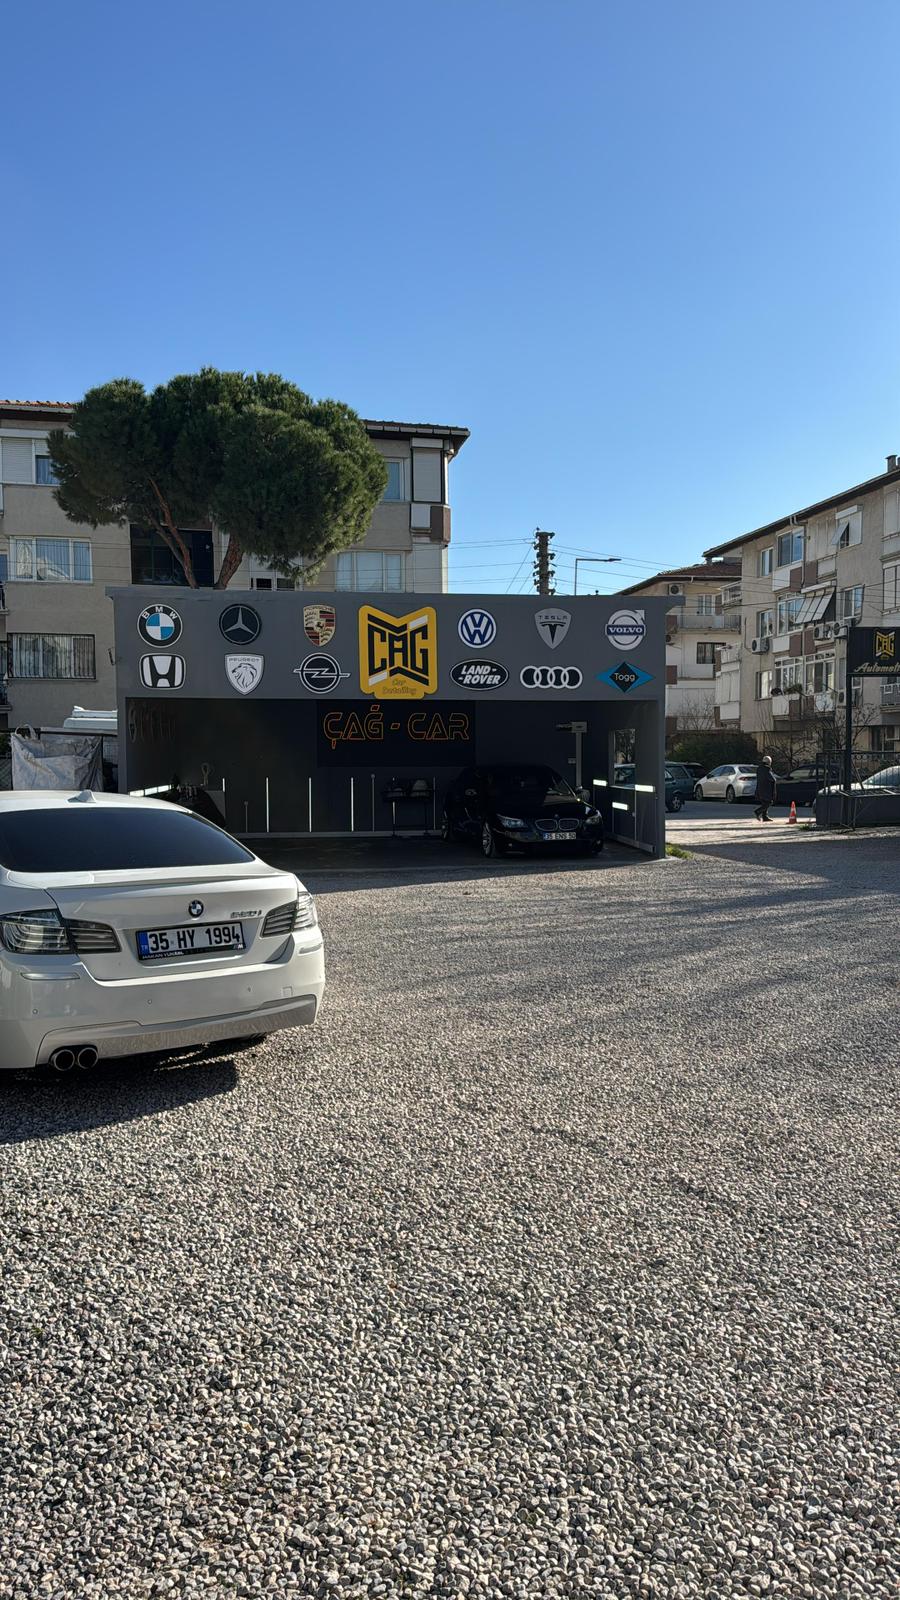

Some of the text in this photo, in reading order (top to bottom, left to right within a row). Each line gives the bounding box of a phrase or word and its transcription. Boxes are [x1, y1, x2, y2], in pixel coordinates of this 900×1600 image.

[141, 606, 178, 620] BMW
[614, 672, 636, 683] Togg
[407, 712, 470, 740] CAR
[148, 925, 240, 952] 35 HY 1994
